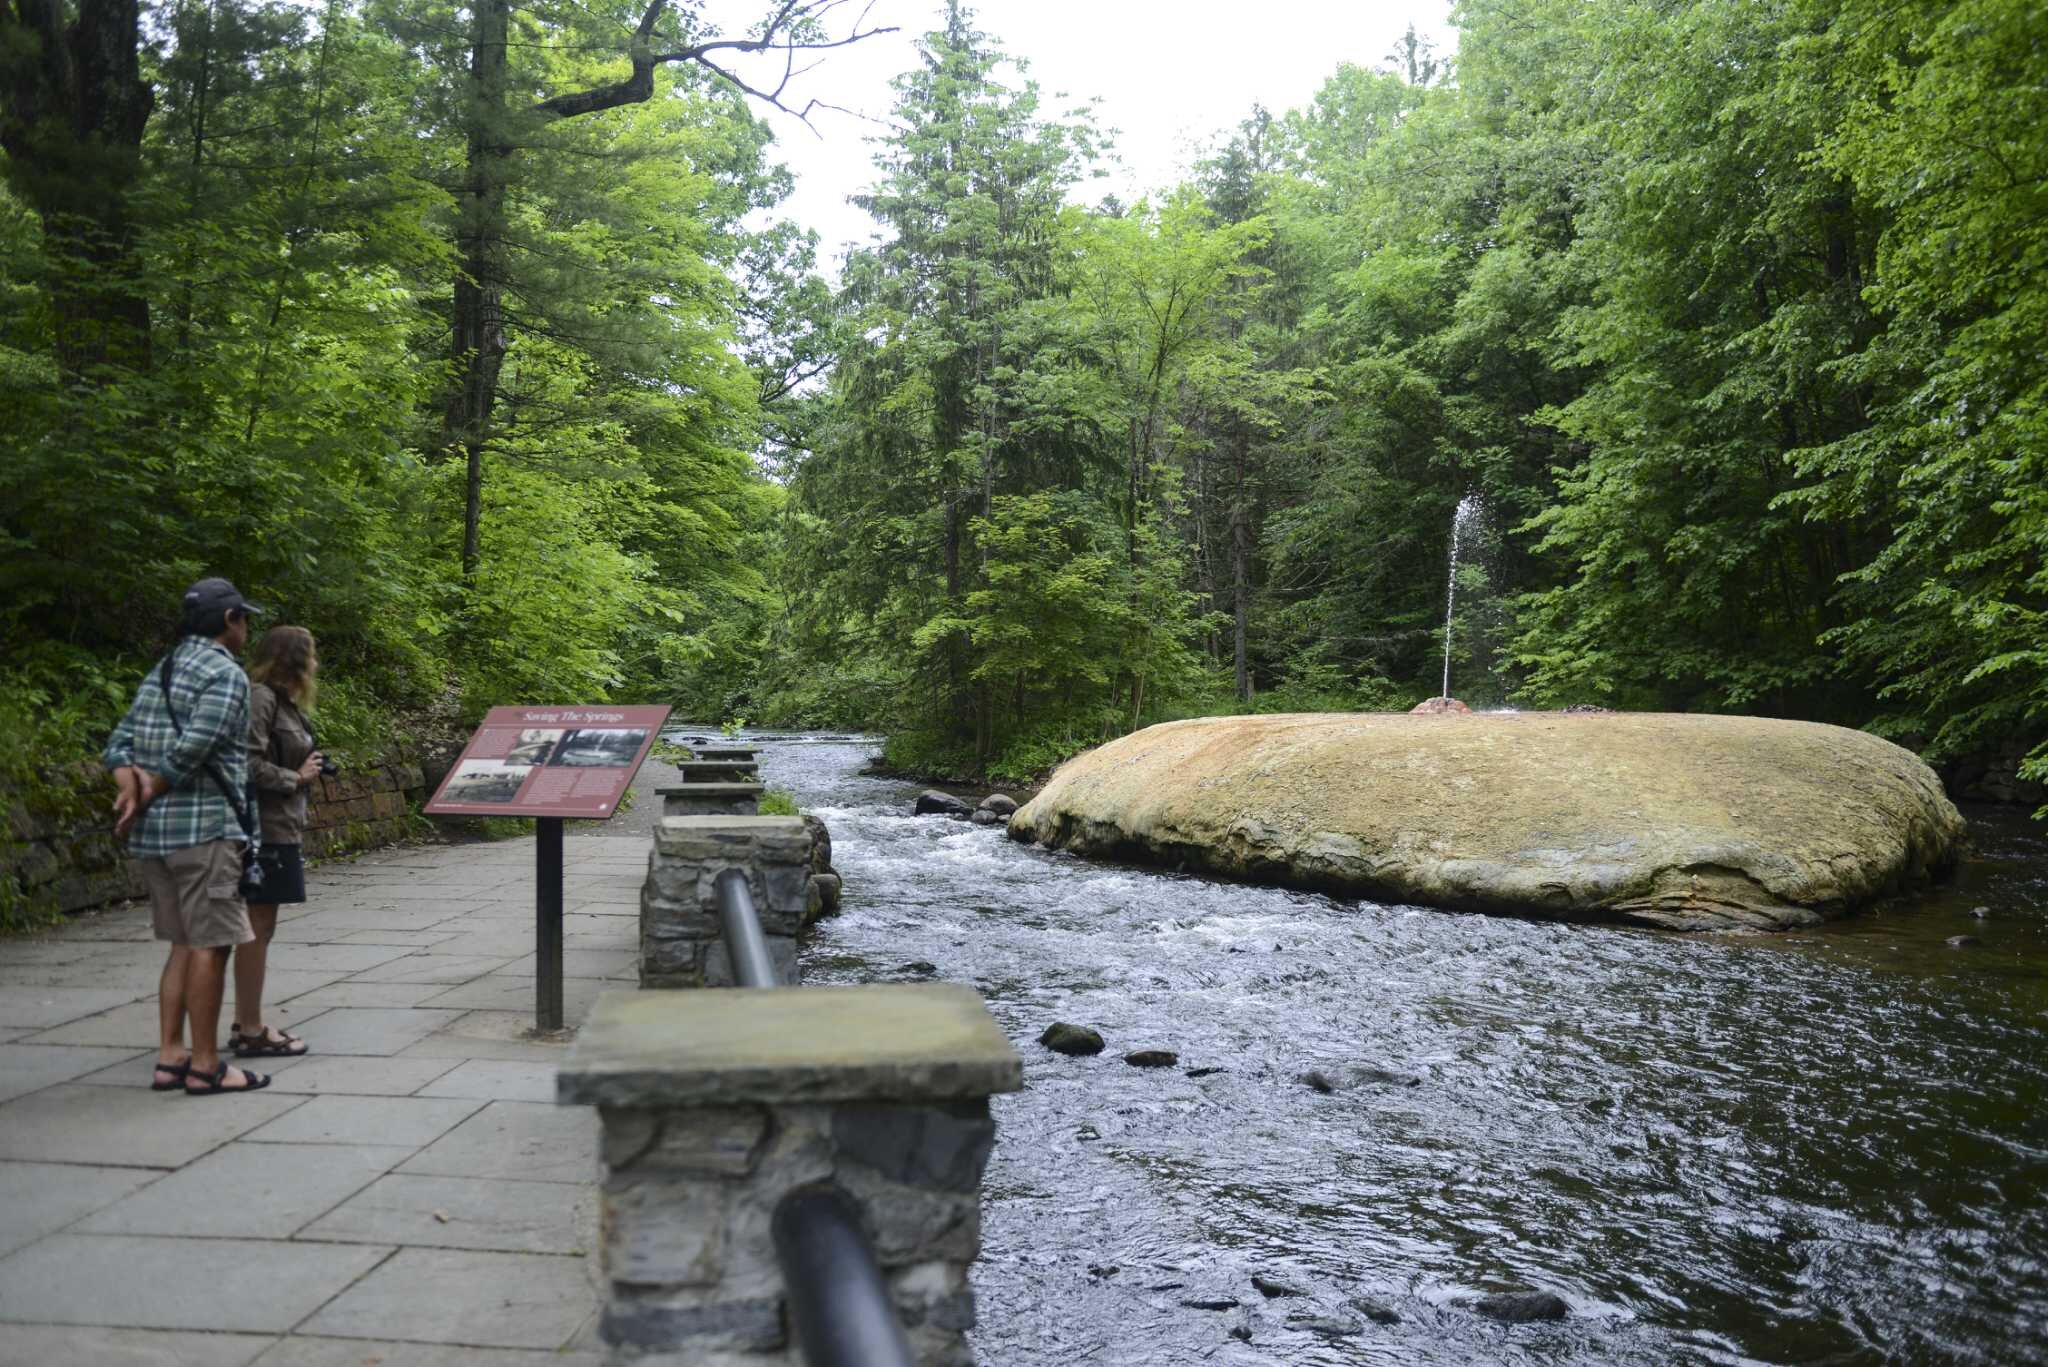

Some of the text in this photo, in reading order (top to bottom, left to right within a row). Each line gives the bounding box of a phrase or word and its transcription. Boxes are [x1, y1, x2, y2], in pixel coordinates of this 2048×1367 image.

[524, 711, 625, 723] Saving The Springs
